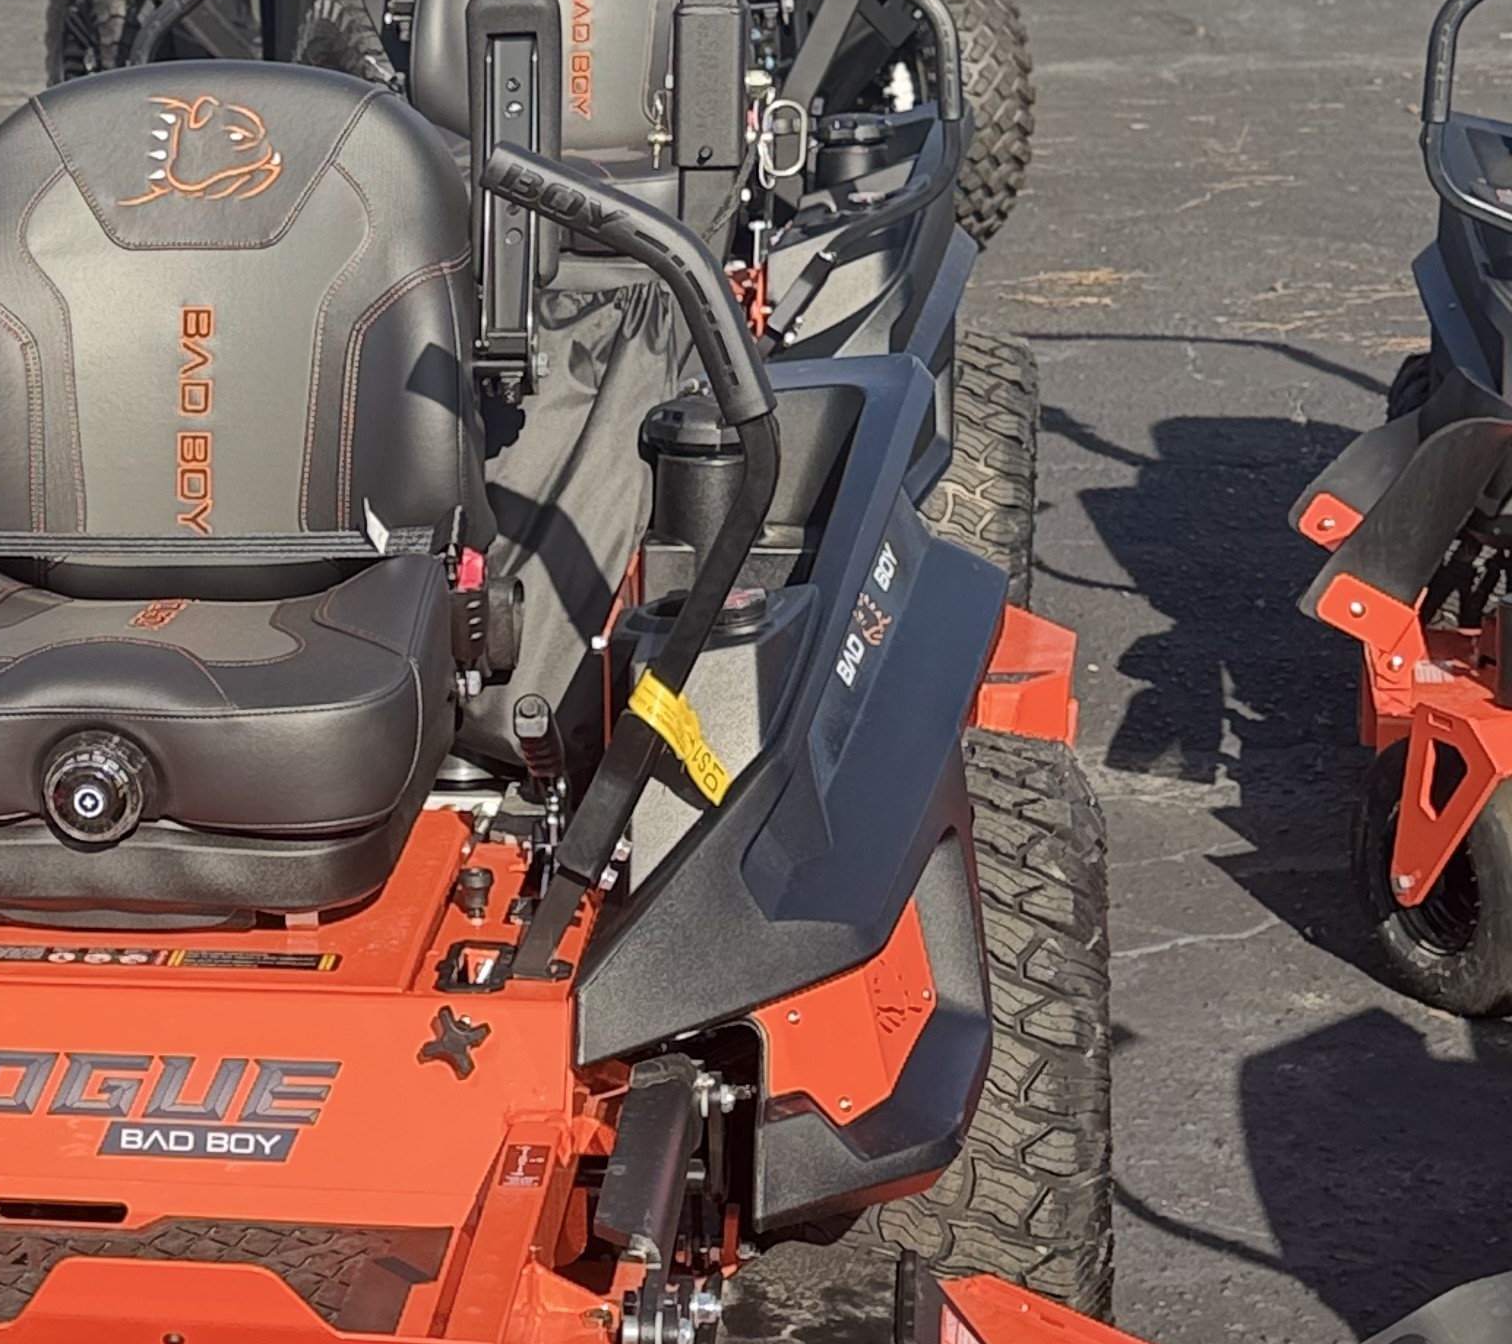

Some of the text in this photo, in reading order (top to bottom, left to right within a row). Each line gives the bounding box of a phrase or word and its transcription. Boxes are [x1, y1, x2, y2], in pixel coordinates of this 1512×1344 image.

[571, 52, 593, 122] BOY
[497, 162, 630, 234] BOY
[176, 305, 215, 536] BAD BOY
[835, 541, 898, 688] BAD BOY
[120, 1128, 282, 1156] BAD BOY
